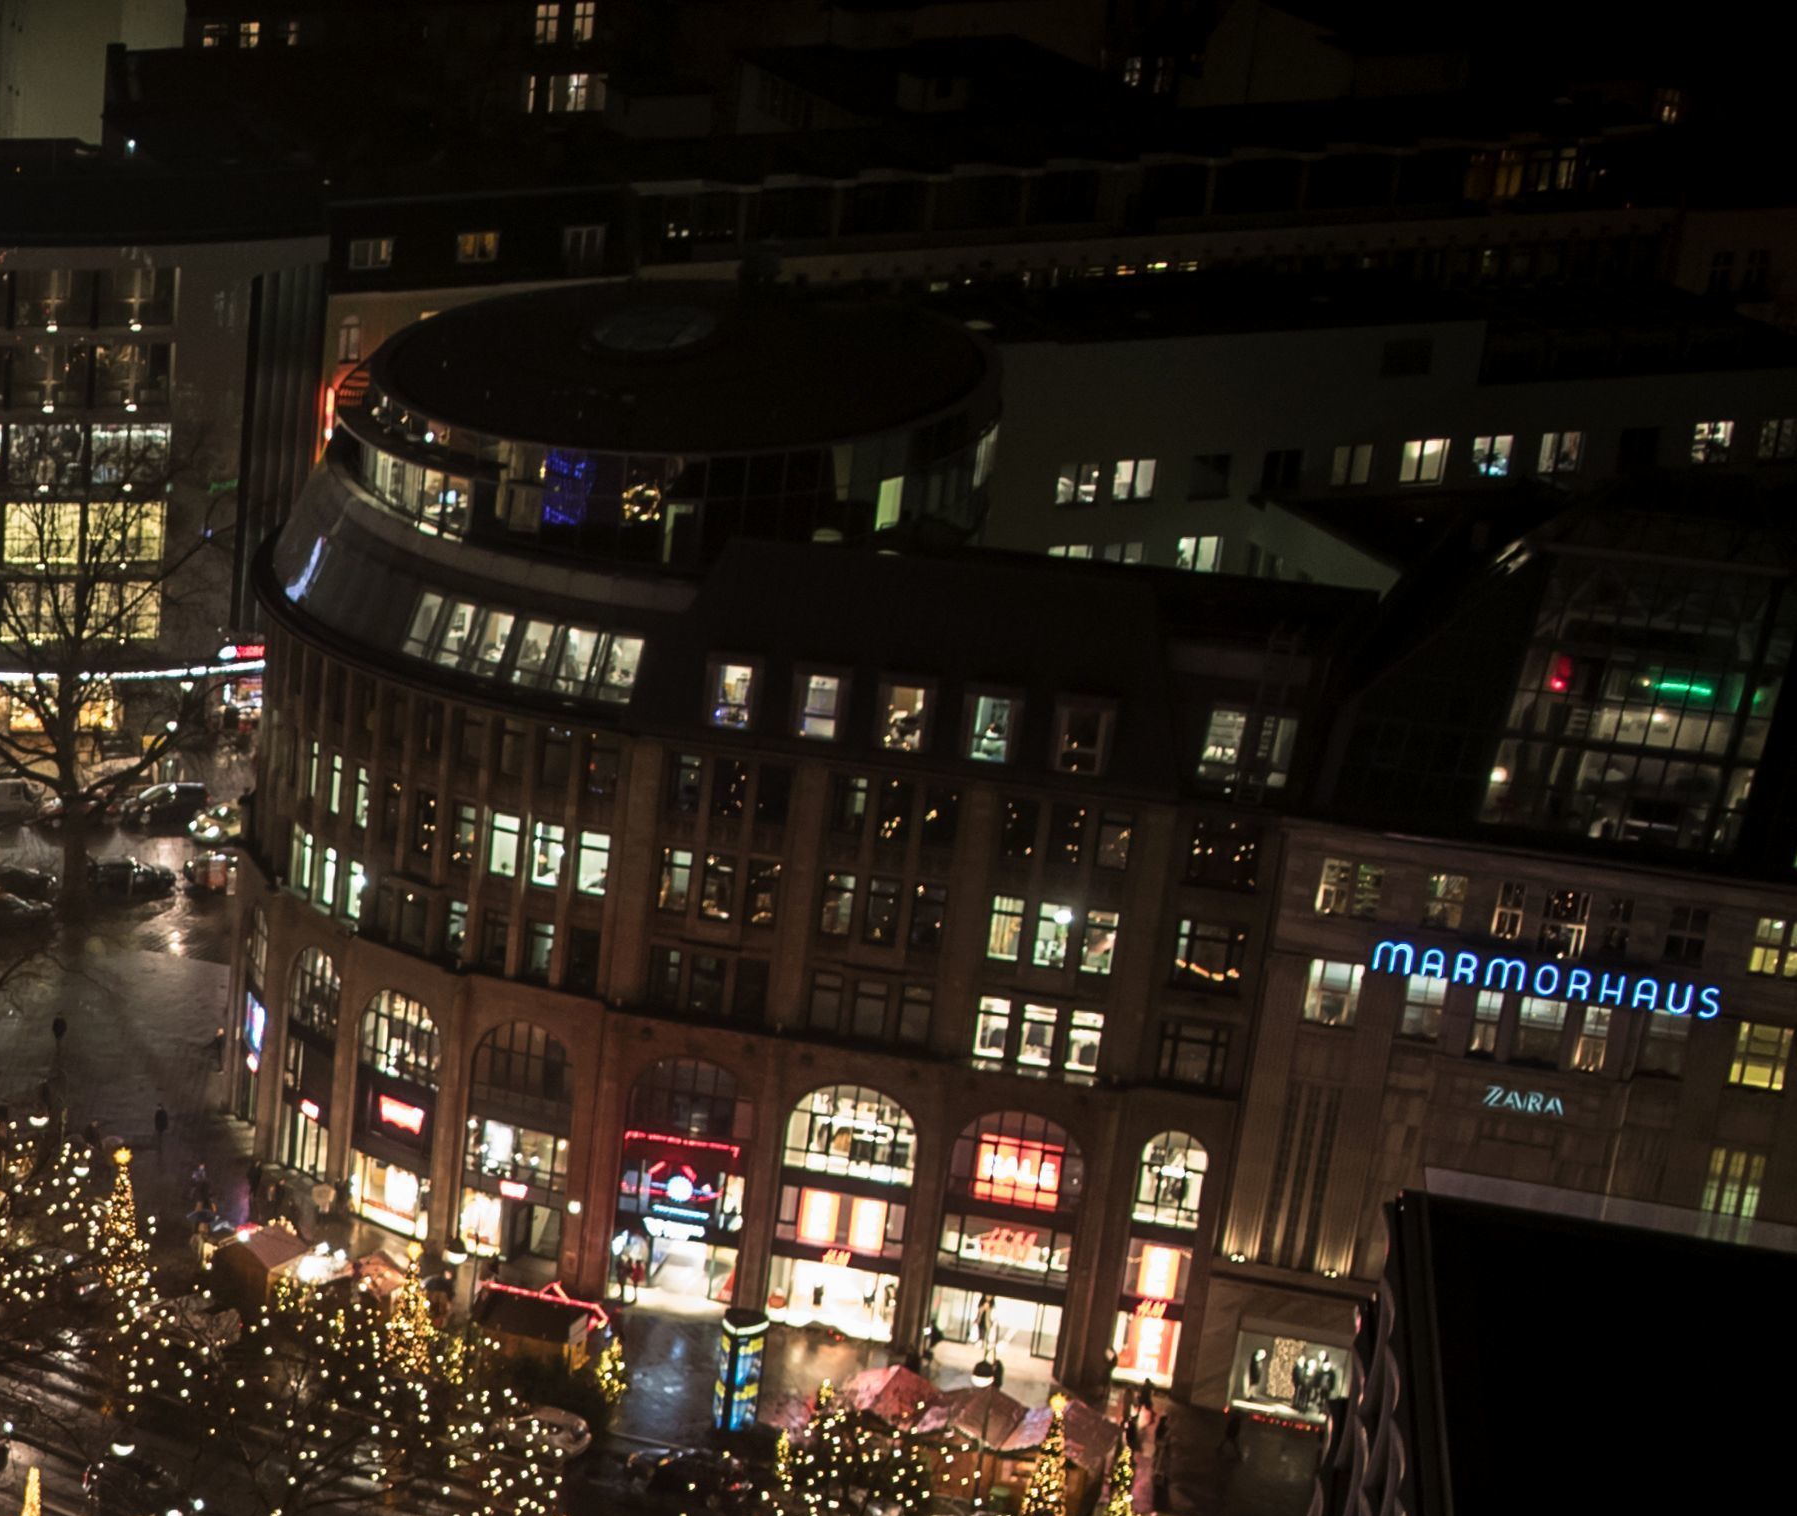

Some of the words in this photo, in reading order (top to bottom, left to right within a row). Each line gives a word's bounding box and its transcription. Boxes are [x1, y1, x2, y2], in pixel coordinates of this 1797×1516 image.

[1370, 939, 1724, 1022] MARMORHAUS
[1483, 1084, 1566, 1117] ZARA
[981, 1152, 1057, 1188] SALE
